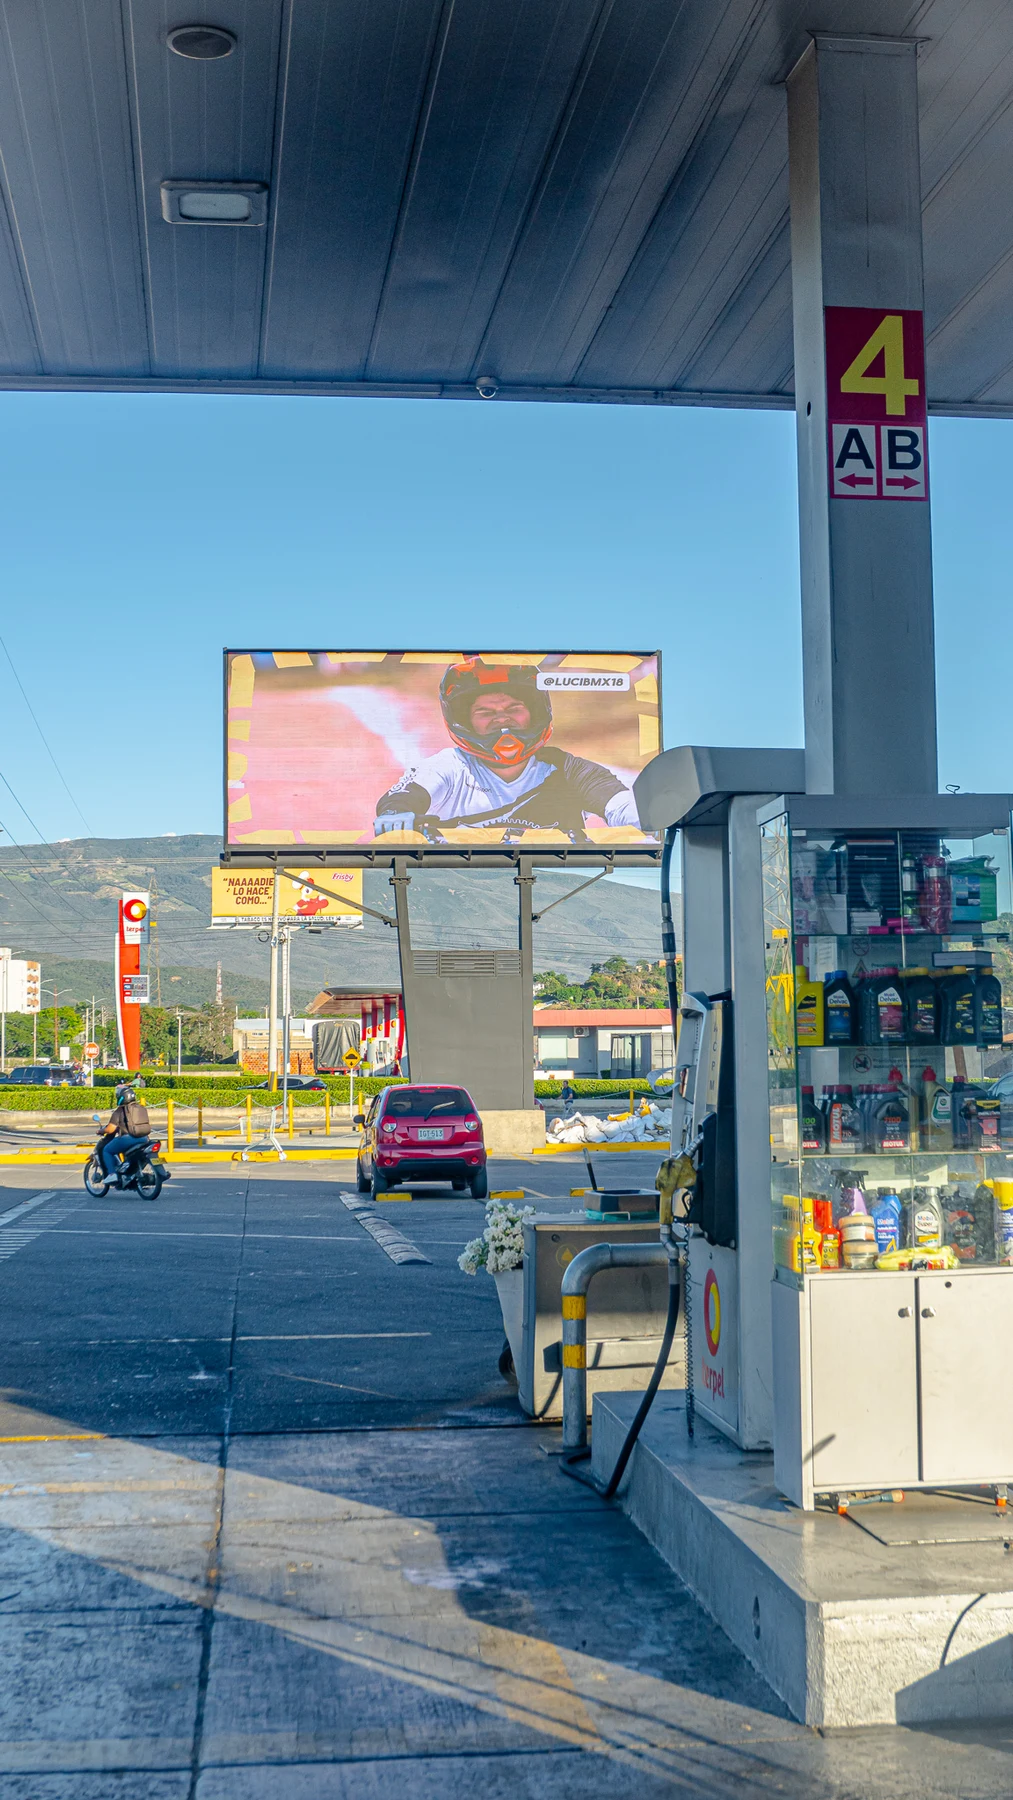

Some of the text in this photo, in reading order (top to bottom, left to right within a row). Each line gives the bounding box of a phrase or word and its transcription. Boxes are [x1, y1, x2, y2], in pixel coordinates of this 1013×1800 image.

[840, 315, 919, 416] 4
[835, 428, 921, 470] A B
[543, 677, 624, 687] @LUCIBMX18
[332, 872, 354, 882] Frisby
[232, 887, 270, 896] LO HACE
[126, 926, 146, 934] terpel
[832, 1107, 841, 1140] MOTUL
[701, 1355, 725, 1401] terpel
